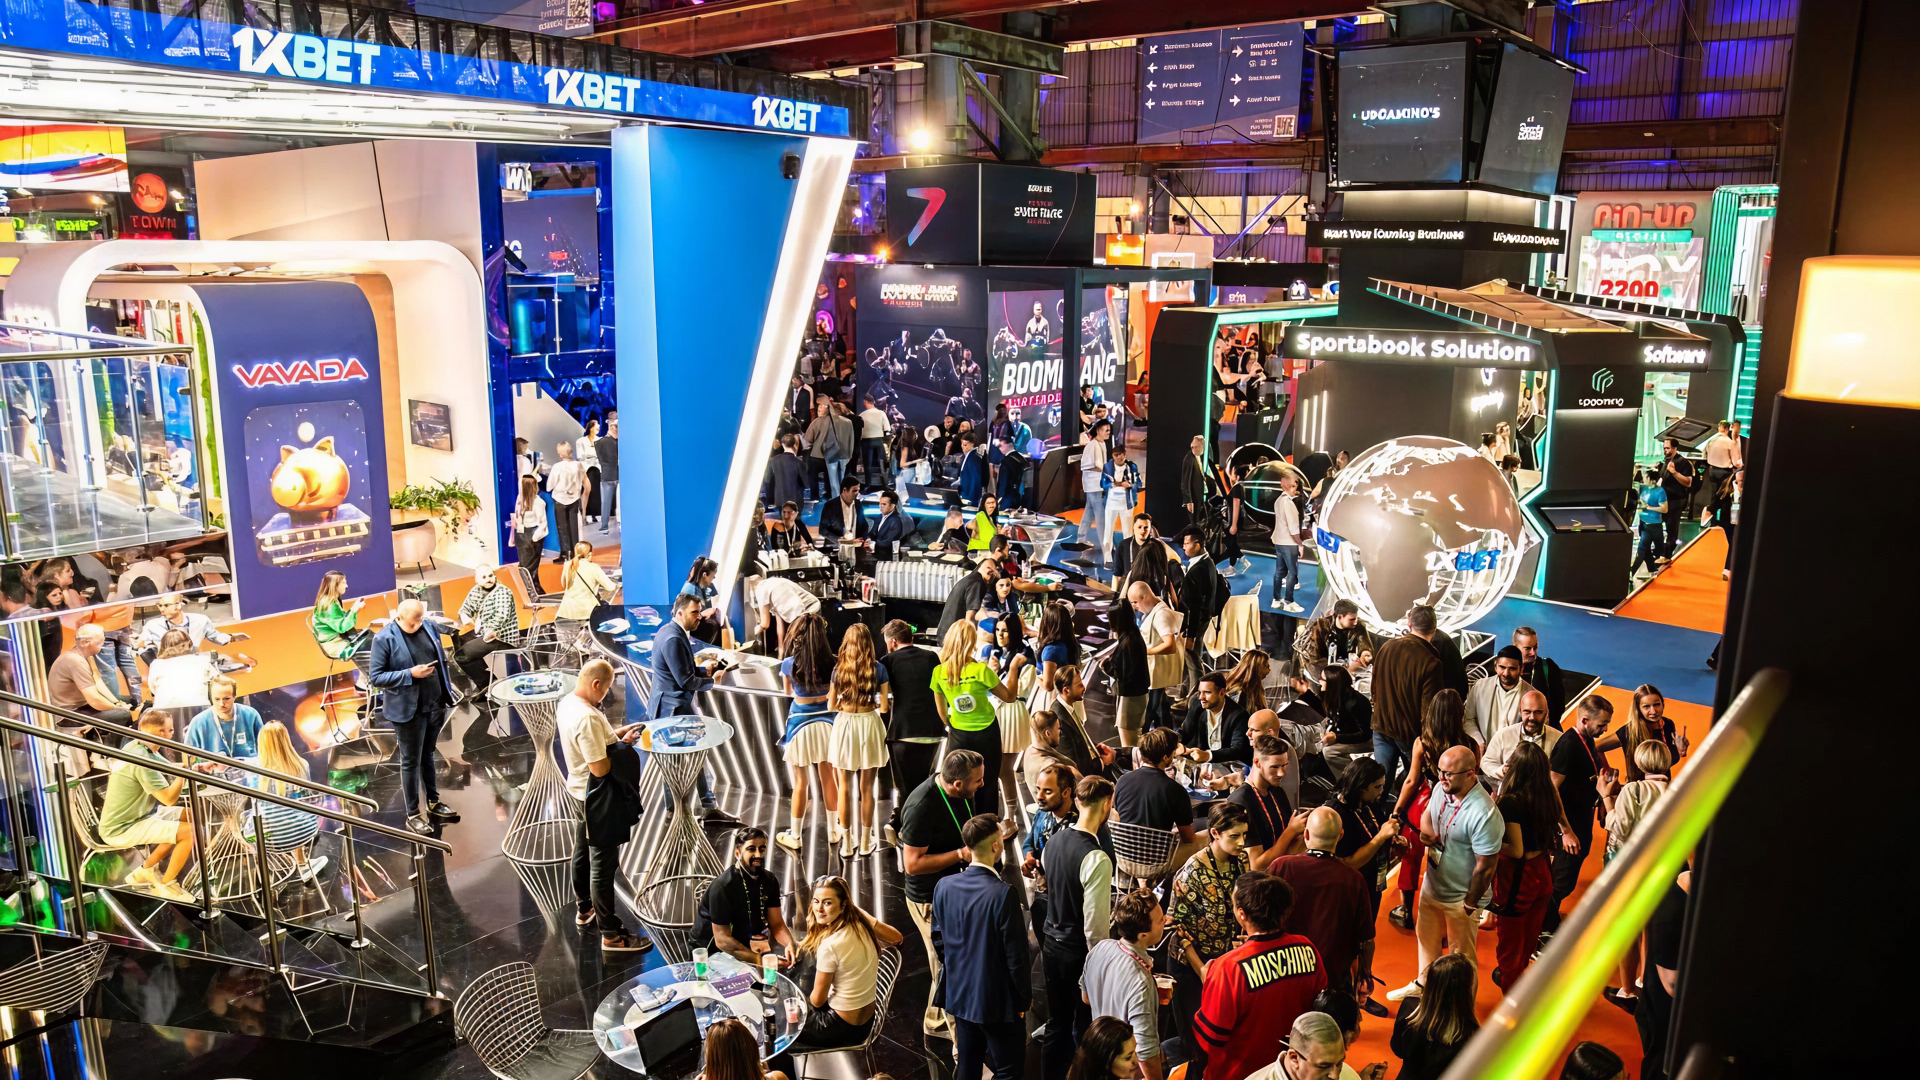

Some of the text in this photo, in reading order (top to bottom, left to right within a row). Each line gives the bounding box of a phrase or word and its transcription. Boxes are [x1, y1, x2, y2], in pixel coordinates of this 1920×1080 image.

[232, 27, 381, 85] 1XBET
[544, 68, 641, 112] 1XBET
[752, 96, 821, 132] 1XBET
[1600, 279, 1659, 297] 2200
[1430, 338, 1531, 362] Solution
[232, 357, 369, 388] VAVADA
